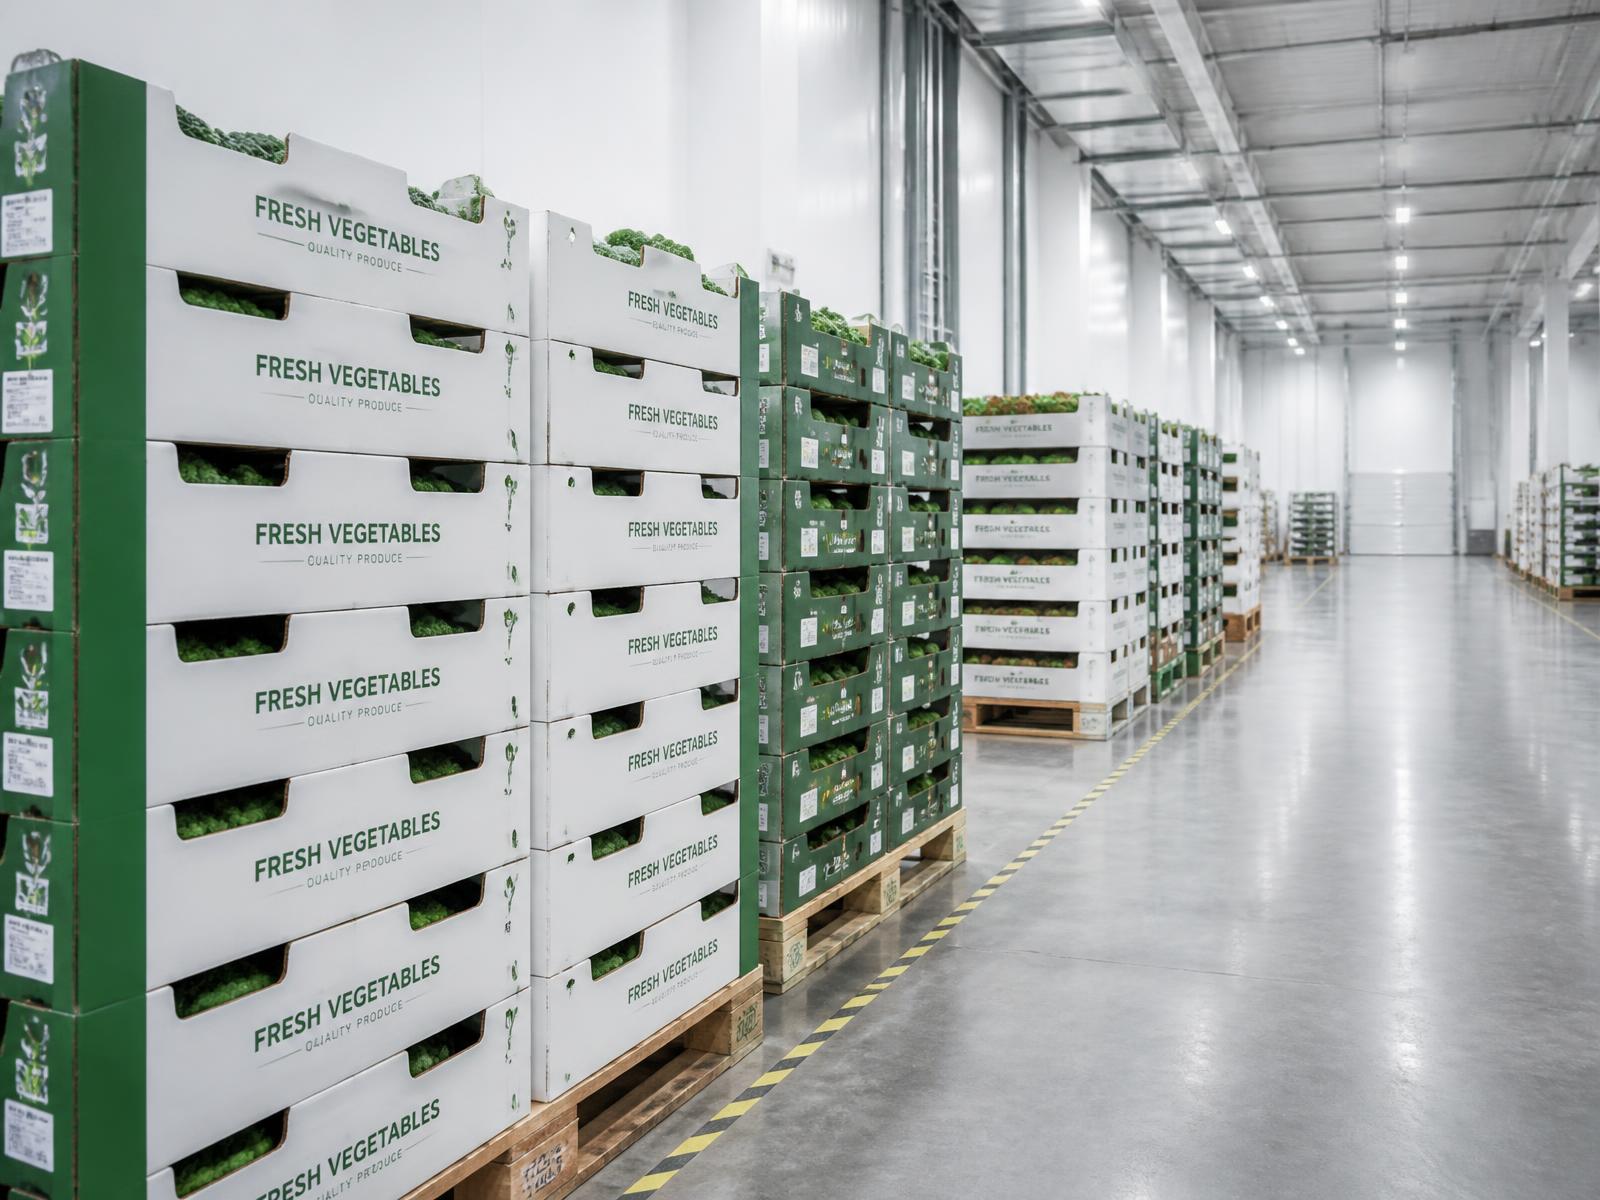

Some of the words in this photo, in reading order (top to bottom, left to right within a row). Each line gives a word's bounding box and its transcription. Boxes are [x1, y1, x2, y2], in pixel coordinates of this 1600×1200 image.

[256, 195, 320, 232] FRESH
[328, 215, 440, 262] VEGETABLES
[357, 253, 402, 272] PRODUCE
[629, 291, 659, 314] FRESH
[663, 302, 718, 330] VEGETABLES
[256, 354, 321, 383] FRESH
[328, 364, 440, 398] VEGETABLES
[358, 398, 402, 412] PRODUCE
[629, 404, 659, 423] FRESH
[663, 409, 718, 431] VEGETABLES
[256, 523, 321, 545] FRESH
[328, 523, 440, 544] VEGETABLES
[629, 522, 659, 538] FRESH
[663, 522, 718, 537] VEGETABLES
[357, 553, 402, 564] PRODUCE
[629, 635, 659, 656] FRESH
[663, 626, 718, 649] VEGETABLES
[256, 683, 321, 714] FRESH
[328, 667, 440, 701] VEGETABLES
[357, 702, 402, 718] PRODUCE
[629, 748, 659, 773] FRESH
[663, 730, 718, 761] VEGETABLES
[255, 843, 321, 882] FRESH
[328, 811, 440, 859] VEGETABLES
[629, 860, 659, 889] FRESH
[663, 834, 718, 872] VEGETABLES
[628, 973, 659, 1005] FRESH
[663, 938, 718, 983] VEGETABLES
[255, 1004, 321, 1052] FRESH
[328, 955, 440, 1018] VEGETABLES
[357, 999, 403, 1029] PRODUCE
[328, 1099, 440, 1176] VEGETABLES
